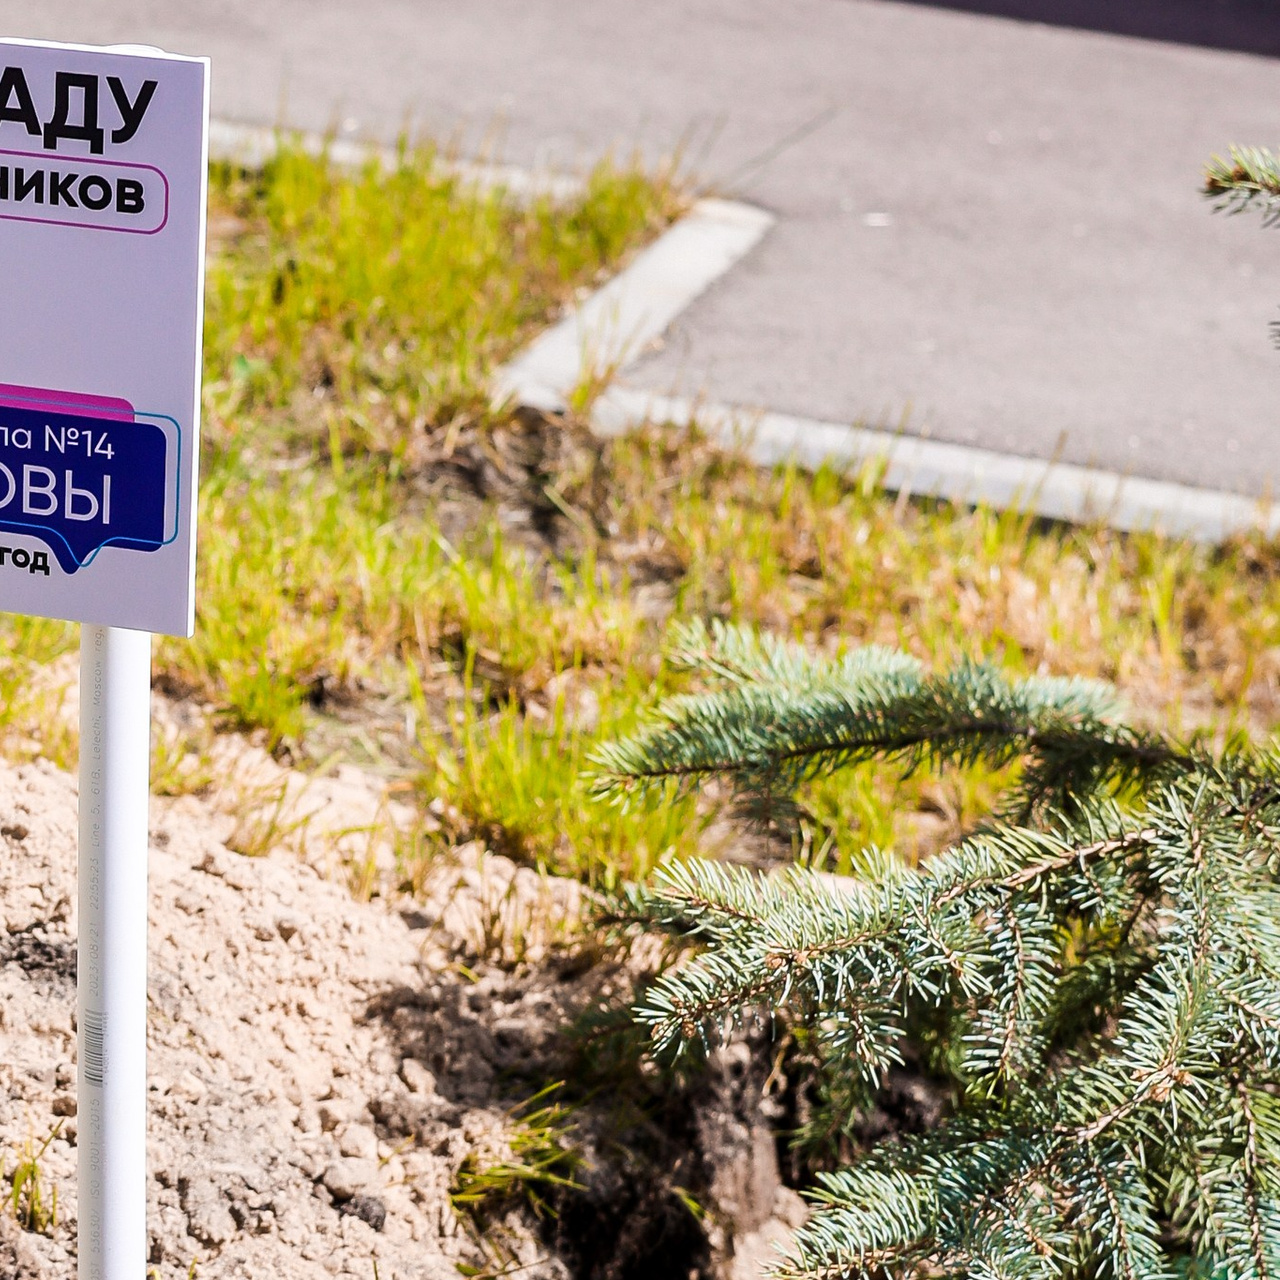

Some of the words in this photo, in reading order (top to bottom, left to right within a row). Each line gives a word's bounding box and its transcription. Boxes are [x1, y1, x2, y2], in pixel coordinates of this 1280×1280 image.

[45, 425, 115, 460] №14
[0, 547, 50, 575] год
[92, 661, 103, 707] Moscow
